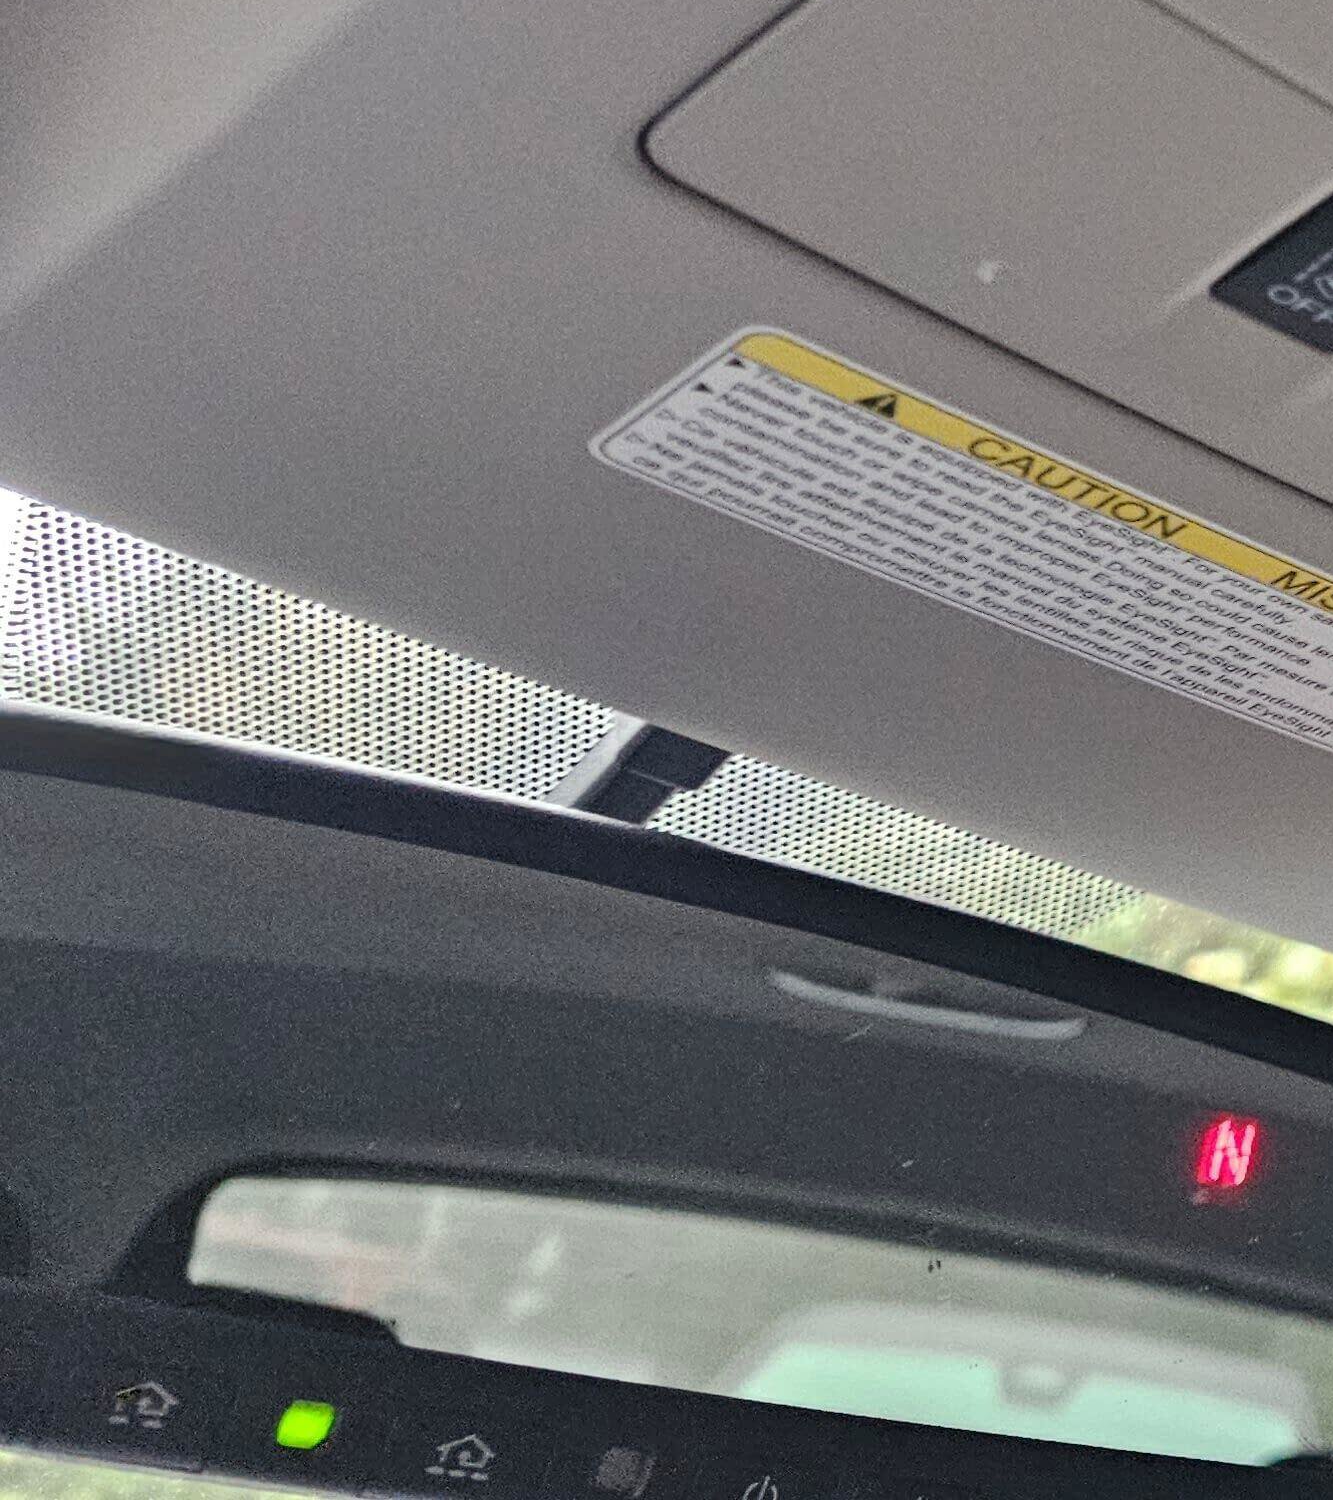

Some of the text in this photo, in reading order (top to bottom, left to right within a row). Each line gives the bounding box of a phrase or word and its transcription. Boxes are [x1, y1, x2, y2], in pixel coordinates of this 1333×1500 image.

[957, 434, 1192, 539] CAUTION
[988, 531, 1092, 577] improper
[1023, 490, 1072, 513] with
[1179, 556, 1225, 577] For
[1217, 574, 1269, 599] your
[1264, 593, 1310, 614] own
[1131, 554, 1212, 590] manual
[975, 595, 1134, 661] fonctionnement
[1102, 560, 1169, 591] Doing
[1192, 598, 1253, 625] could
[1248, 622, 1311, 649] cause
[1119, 638, 1187, 667] risque
[1219, 644, 1259, 662] Par
[1256, 660, 1330, 692] mesure
[1203, 1118, 1257, 1186] N
